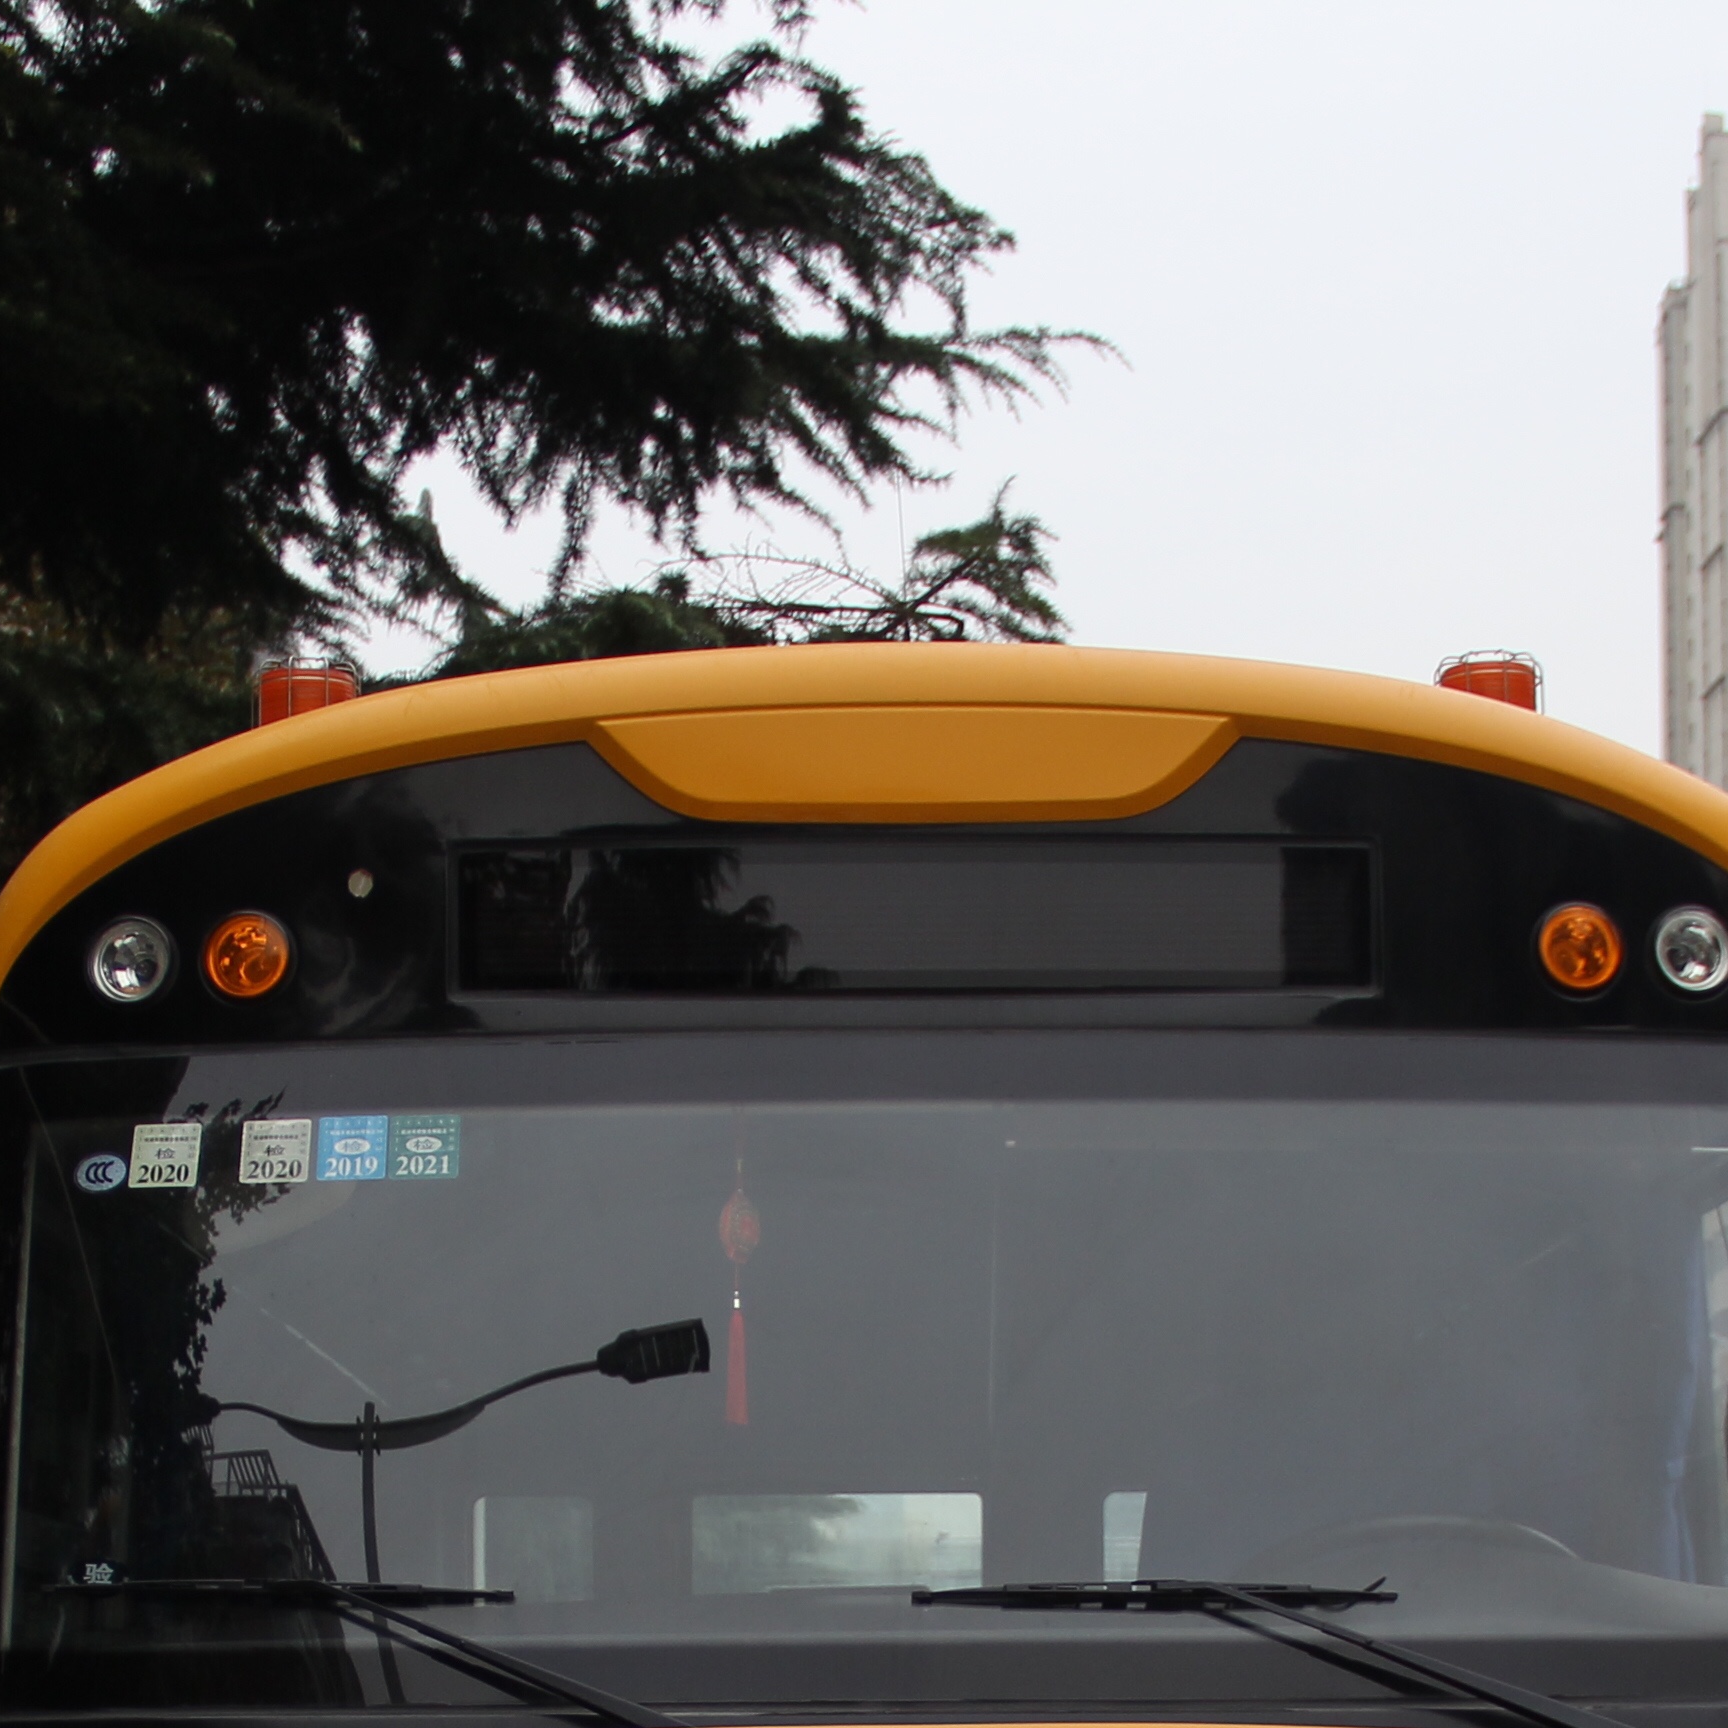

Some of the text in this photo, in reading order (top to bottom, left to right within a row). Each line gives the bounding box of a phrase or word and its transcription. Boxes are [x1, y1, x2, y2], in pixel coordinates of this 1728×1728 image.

[85, 1160, 115, 1184] CCC
[136, 1163, 190, 1184] 2020
[246, 1159, 302, 1179] 2020
[324, 1156, 378, 1178] 2019
[395, 1154, 450, 1176] 2021
[83, 1562, 114, 1584] 验
